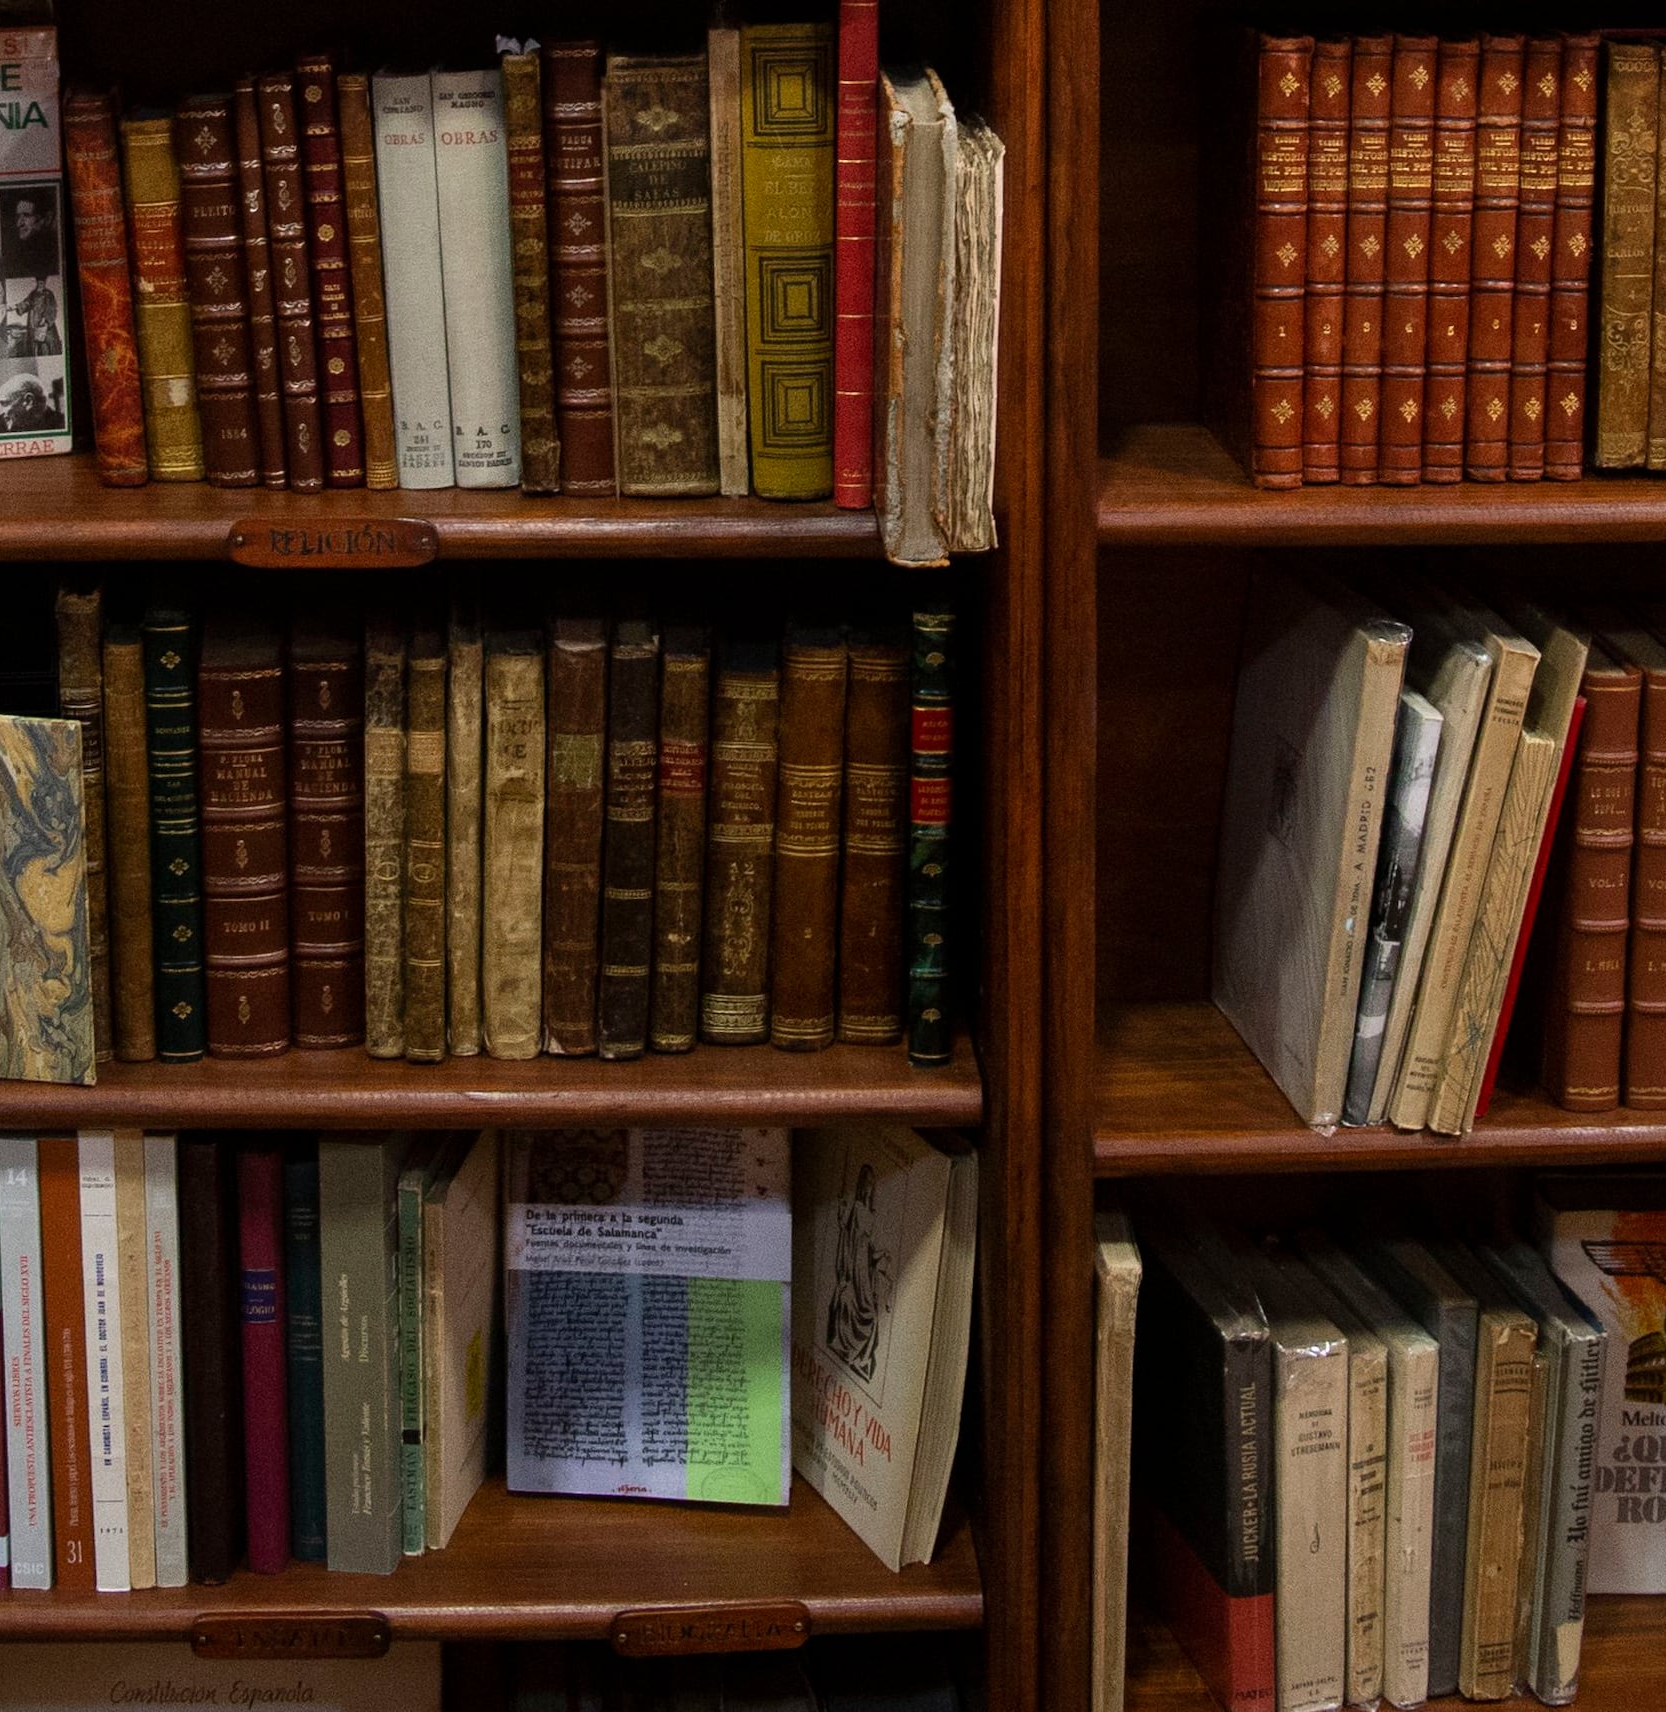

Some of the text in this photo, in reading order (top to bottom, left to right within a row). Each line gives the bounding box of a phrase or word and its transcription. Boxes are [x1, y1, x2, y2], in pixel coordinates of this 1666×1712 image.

[383, 132, 425, 146] OBRAS
[441, 129, 499, 146] OBRAS
[216, 768, 267, 780] MANUAL
[300, 756, 352, 770] MANUAL
[1357, 801, 1372, 854] MADRID
[526, 1209, 684, 1227] De primera segunda
[404, 1235, 417, 1318] SOCIALISMO
[358, 1314, 369, 1364] Discursos
[20, 1277, 37, 1508] PROPUESTA ANTIESCLAVISTA FINALES SIGLO
[1575, 1338, 1602, 1481] amigo Hitler
[1239, 1382, 1260, 1561] JUCKER RUSIA ACTUAL
[67, 1540, 83, 1564] 31
[1568, 1559, 1584, 1621] Hoffmann
